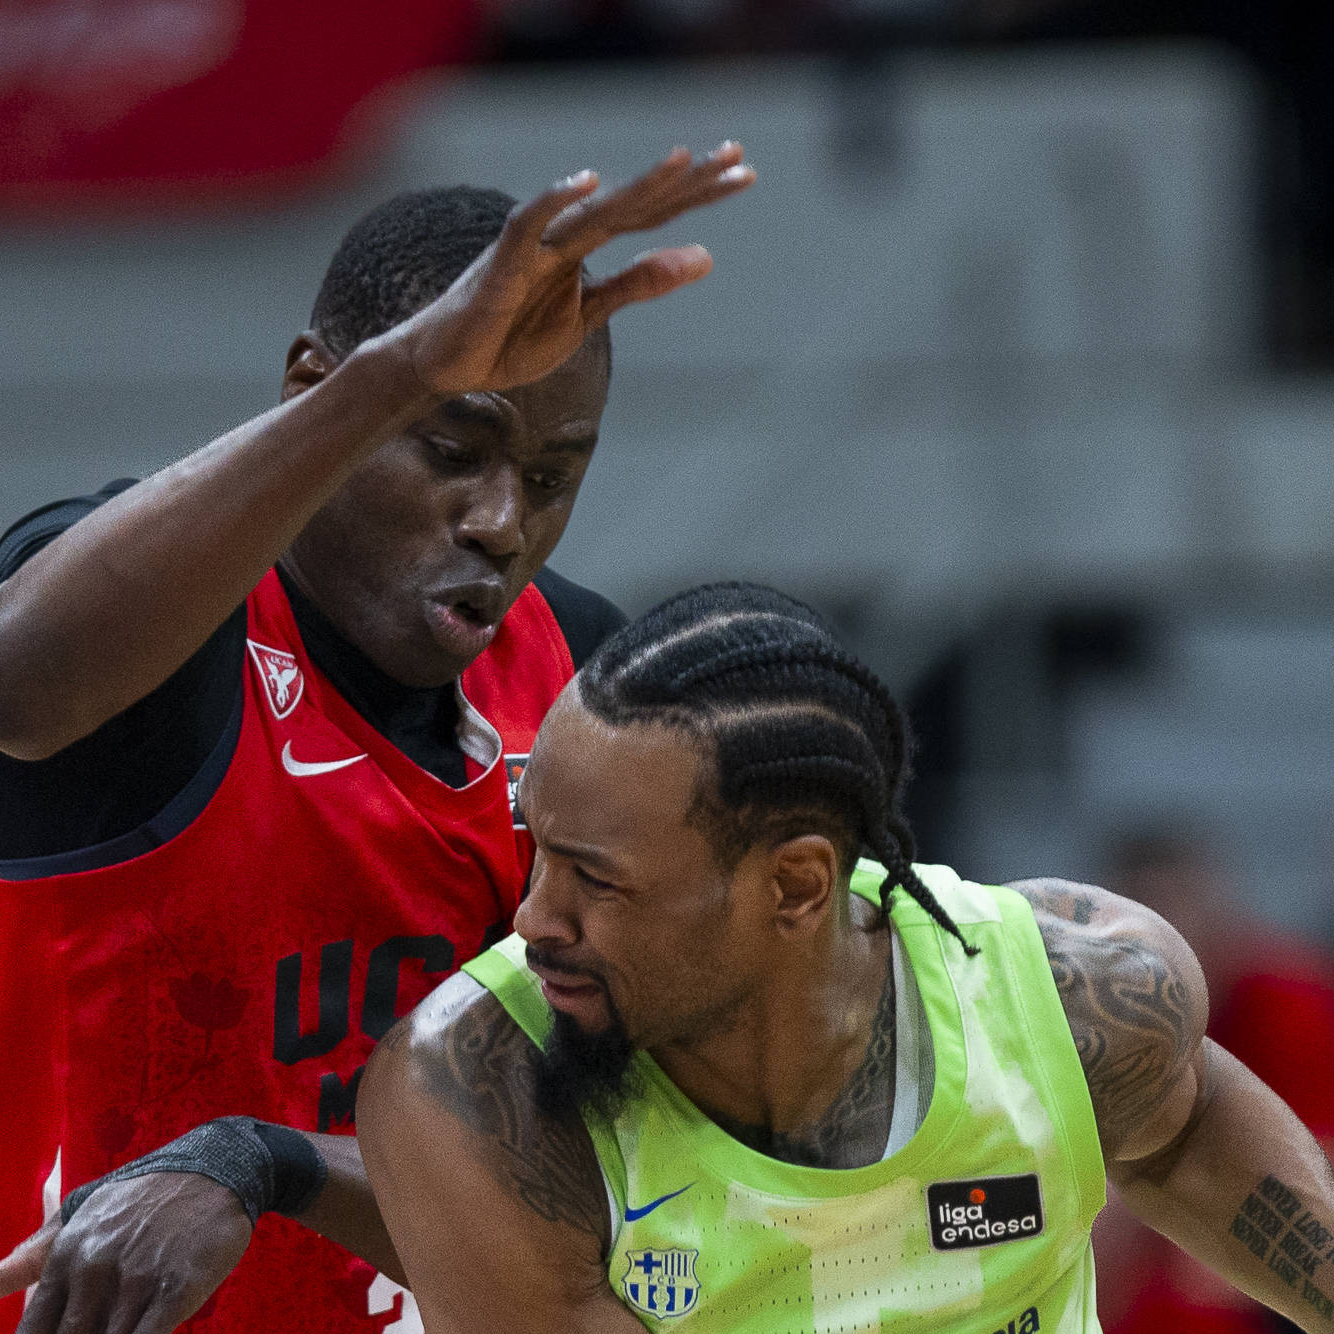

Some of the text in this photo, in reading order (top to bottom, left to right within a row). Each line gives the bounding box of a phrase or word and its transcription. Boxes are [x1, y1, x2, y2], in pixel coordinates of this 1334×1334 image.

[273, 917, 512, 1066] UC
[939, 1203, 983, 1226] liga
[941, 1215, 1036, 1242] endesa
